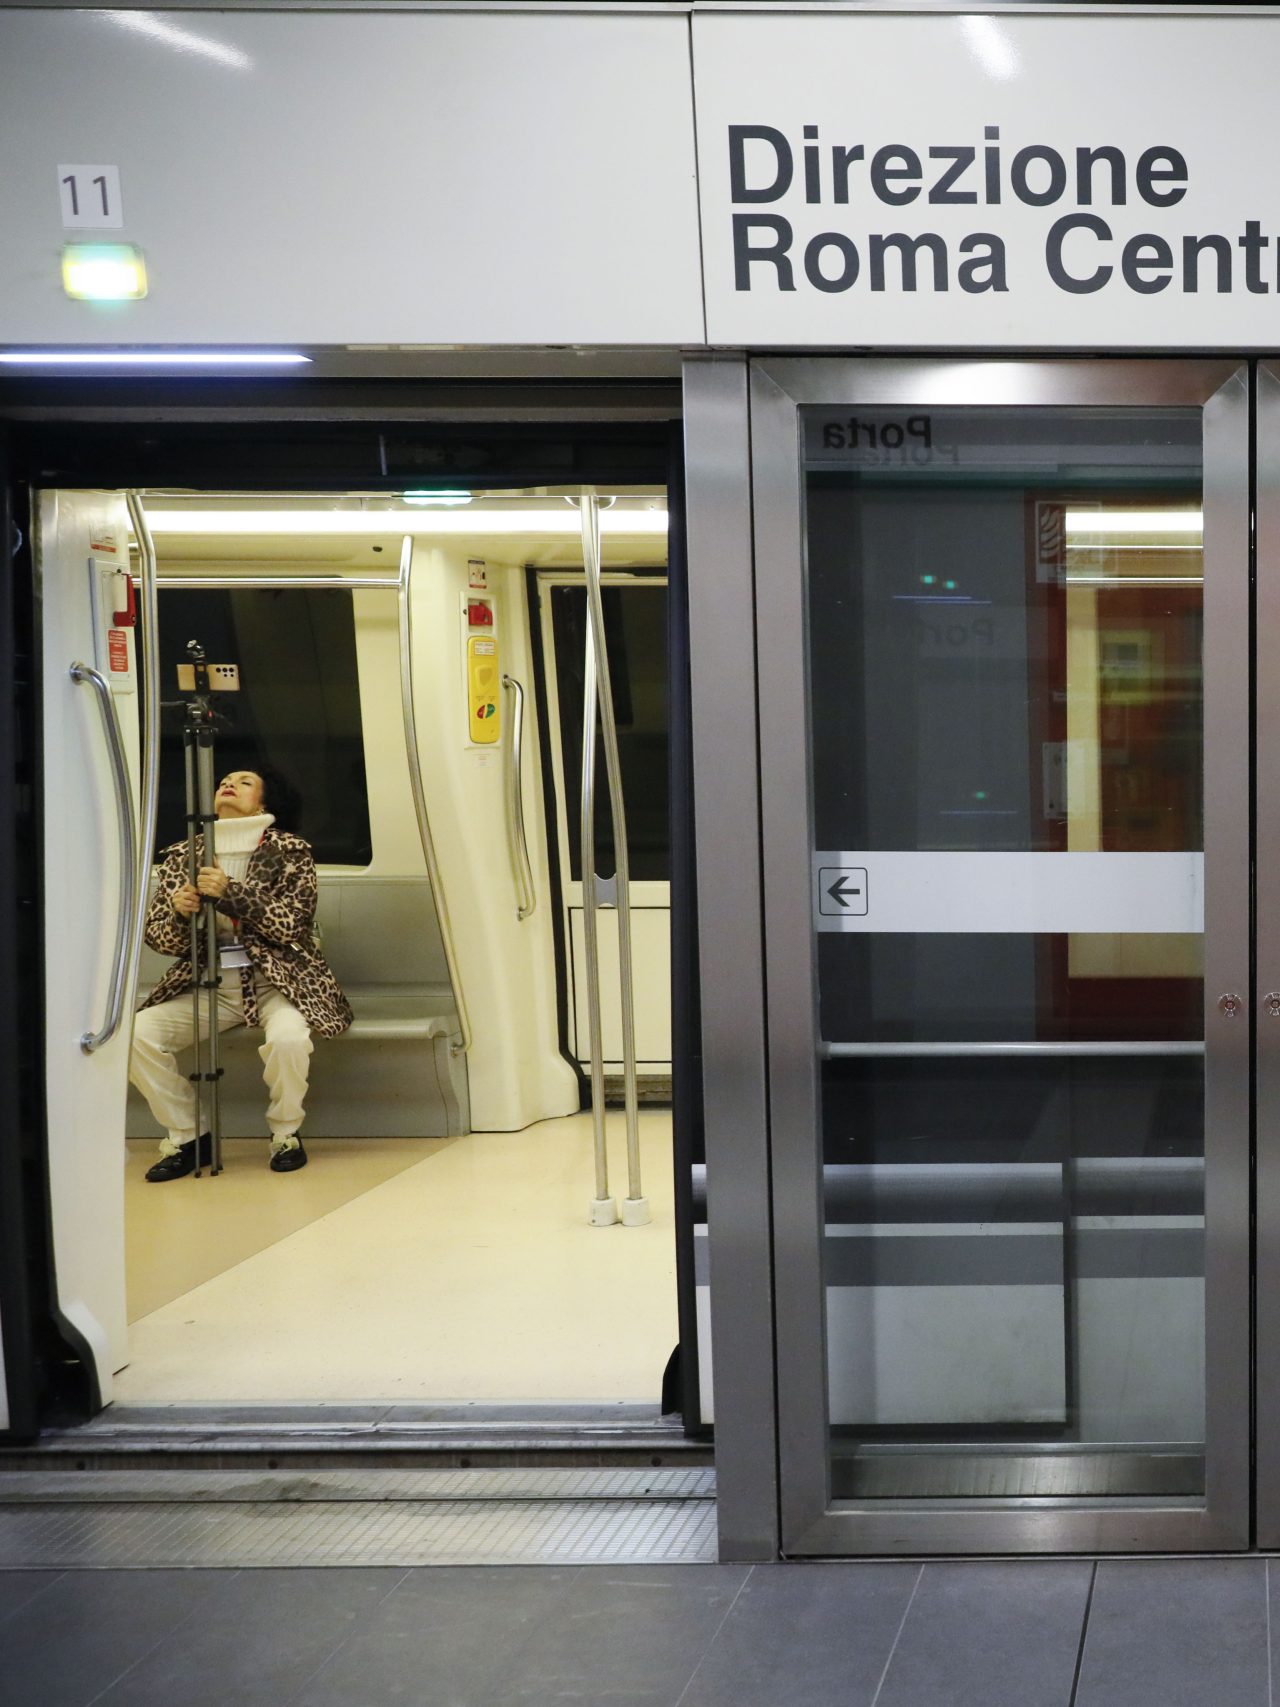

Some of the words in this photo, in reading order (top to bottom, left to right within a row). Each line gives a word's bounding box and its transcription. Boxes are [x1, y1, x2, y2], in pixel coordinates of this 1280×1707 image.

[62, 175, 109, 216] 11
[728, 124, 1189, 208] Direzione
[732, 213, 1010, 294] Roma
